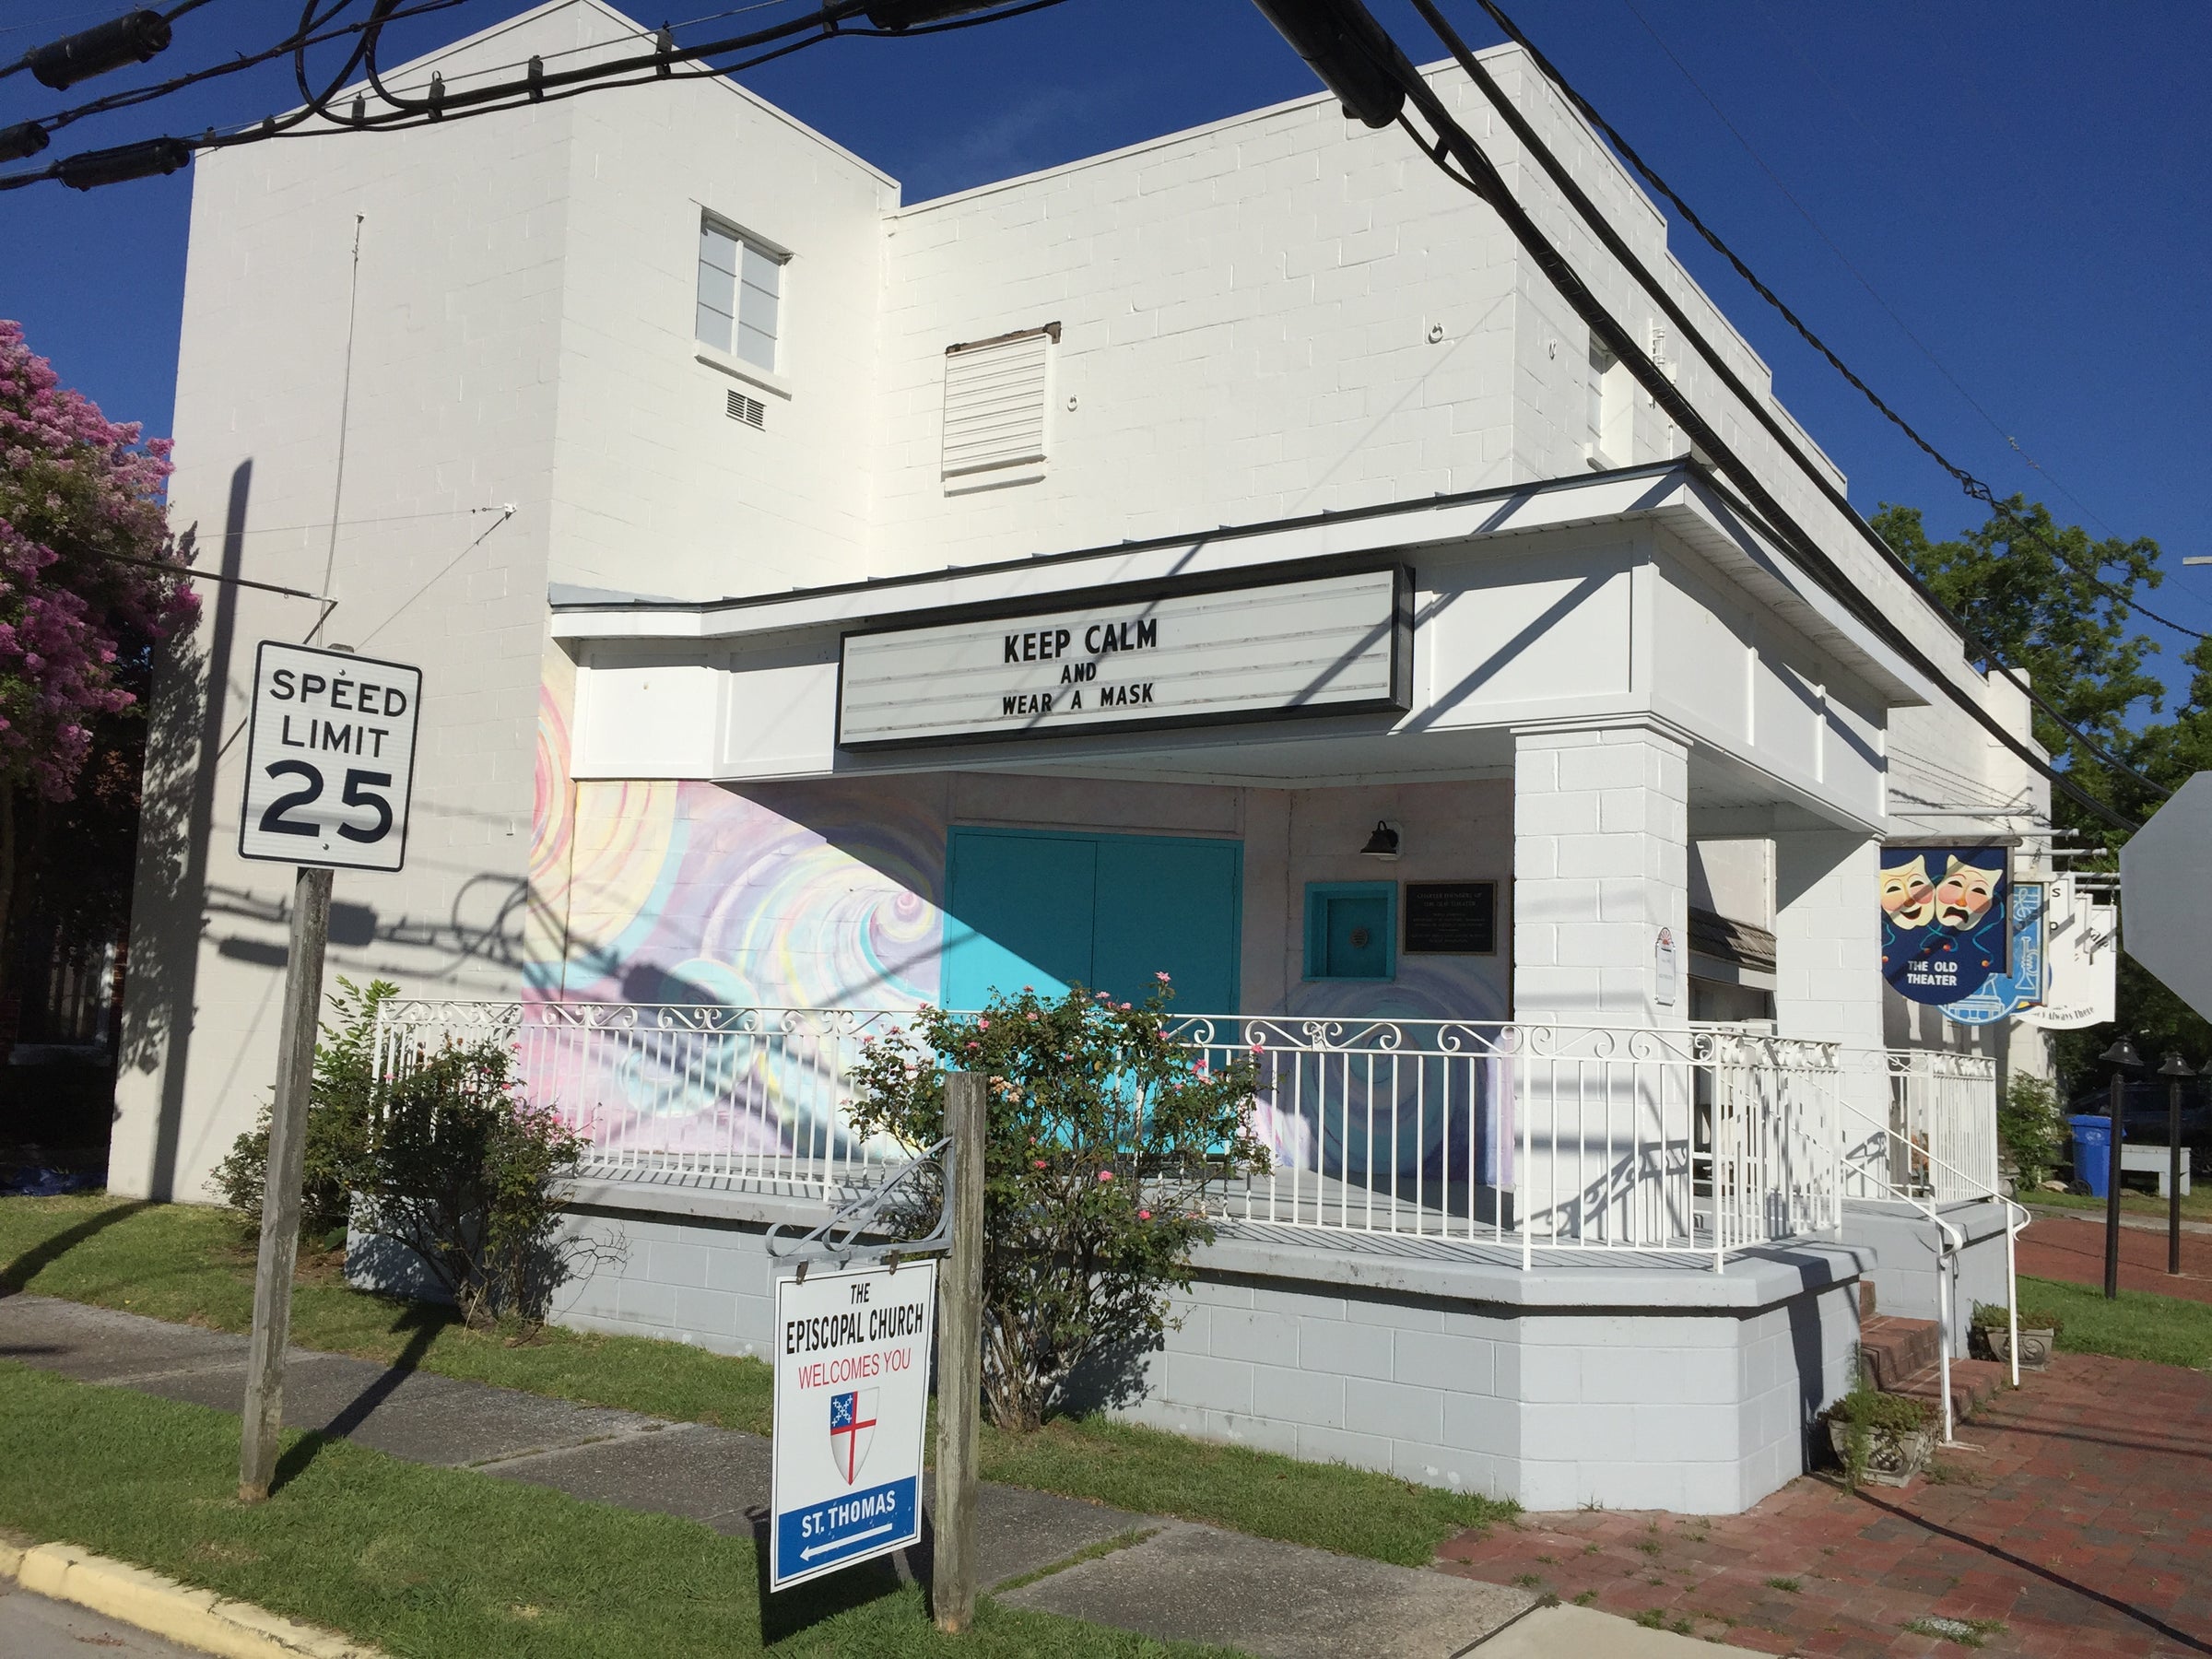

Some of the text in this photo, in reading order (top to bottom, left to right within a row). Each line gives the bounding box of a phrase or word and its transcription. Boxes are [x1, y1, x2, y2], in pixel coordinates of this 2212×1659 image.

[1005, 618, 1157, 663] KEEP CALM
[269, 669, 407, 717] SPEED
[1061, 662, 1097, 684] AND
[1003, 683, 1153, 715] WEAR A MASK
[282, 715, 389, 758] LIMIT
[258, 759, 394, 844] 25
[1907, 973, 1958, 986] THEATER
[1908, 960, 1958, 972] THE OLD
[851, 1282, 870, 1305] THE
[786, 1302, 924, 1355] EPISCOPAL CHURCH
[798, 1347, 911, 1390] WELCOMES YOU
[801, 1489, 896, 1538] ST. THOMAS
